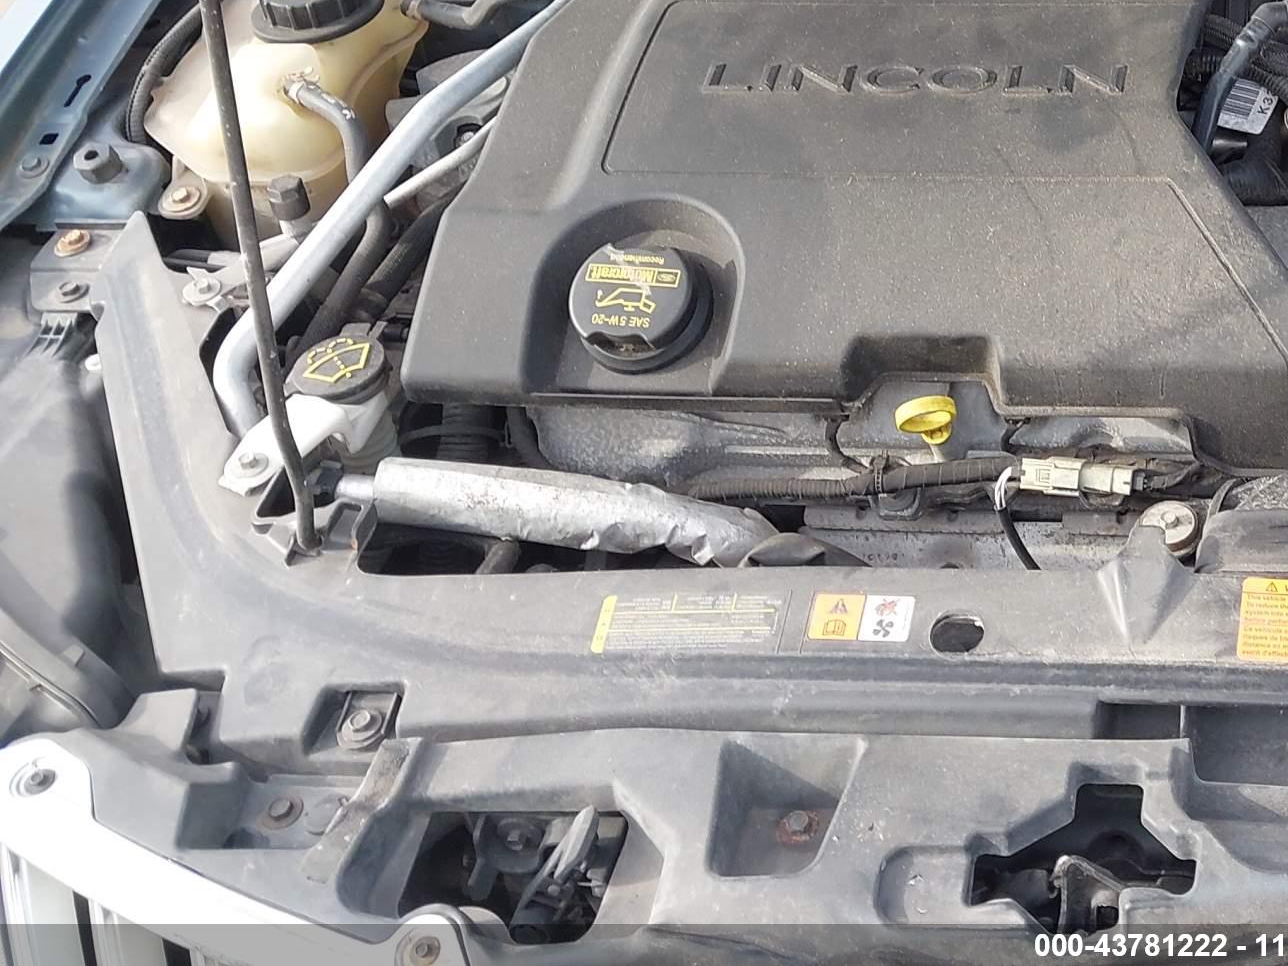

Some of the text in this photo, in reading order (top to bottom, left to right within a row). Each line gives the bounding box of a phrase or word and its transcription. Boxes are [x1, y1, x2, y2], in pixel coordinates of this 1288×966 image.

[702, 63, 1129, 95] LINCOLN
[591, 265, 654, 283] Motorcraft
[591, 313, 650, 328] SAE 5W-20
[1262, 595, 1286, 603] vehicle
